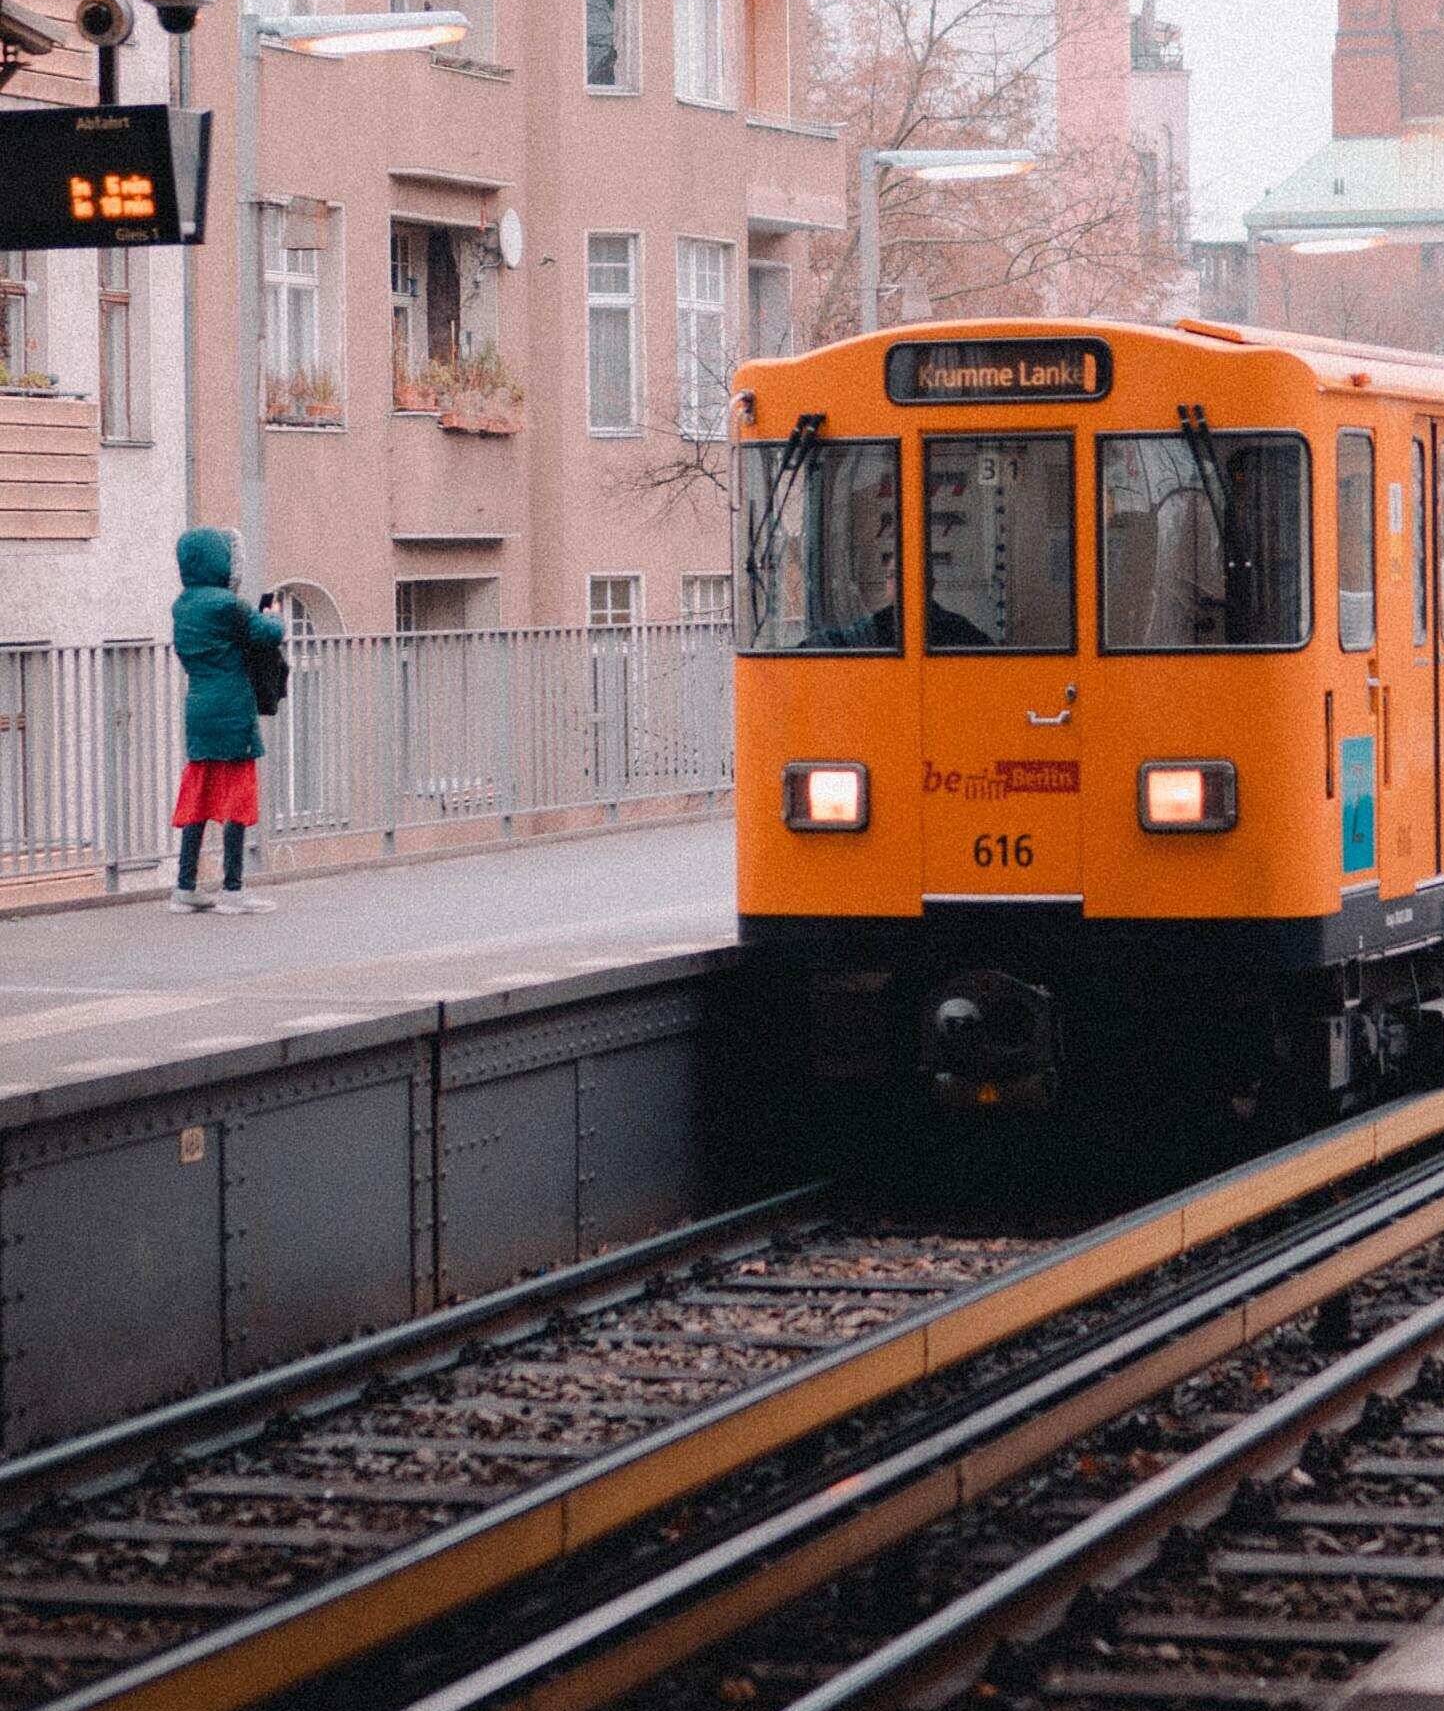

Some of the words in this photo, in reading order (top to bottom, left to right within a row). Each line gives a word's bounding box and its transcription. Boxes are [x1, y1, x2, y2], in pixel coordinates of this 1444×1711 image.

[918, 363, 1013, 388] Krumme
[1018, 360, 1083, 387] Lanke
[922, 760, 961, 793] be
[973, 833, 1034, 868] 616
